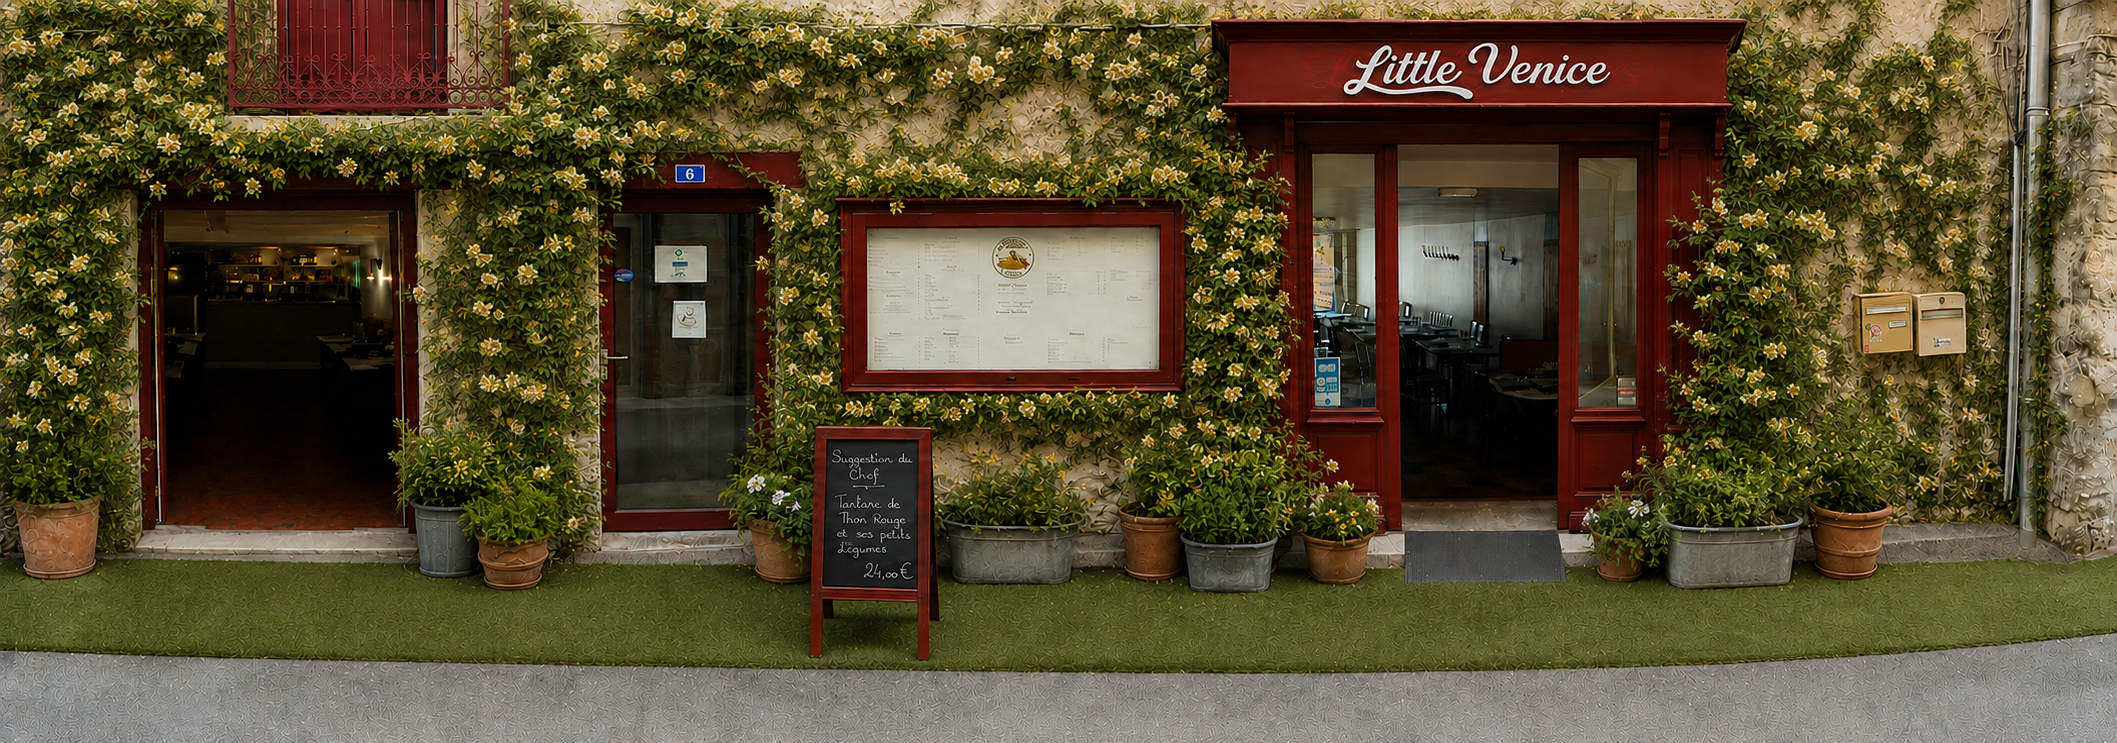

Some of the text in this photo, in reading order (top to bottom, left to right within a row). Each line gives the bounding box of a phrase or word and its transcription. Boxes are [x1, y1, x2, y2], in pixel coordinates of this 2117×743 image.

[1343, 42, 1611, 100] Little Venice
[685, 167, 695, 180] 6
[832, 449, 913, 468] Suggestion du
[887, 497, 901, 509] de
[838, 511, 906, 530] Thon Rouge
[836, 528, 911, 544] et ses petits
